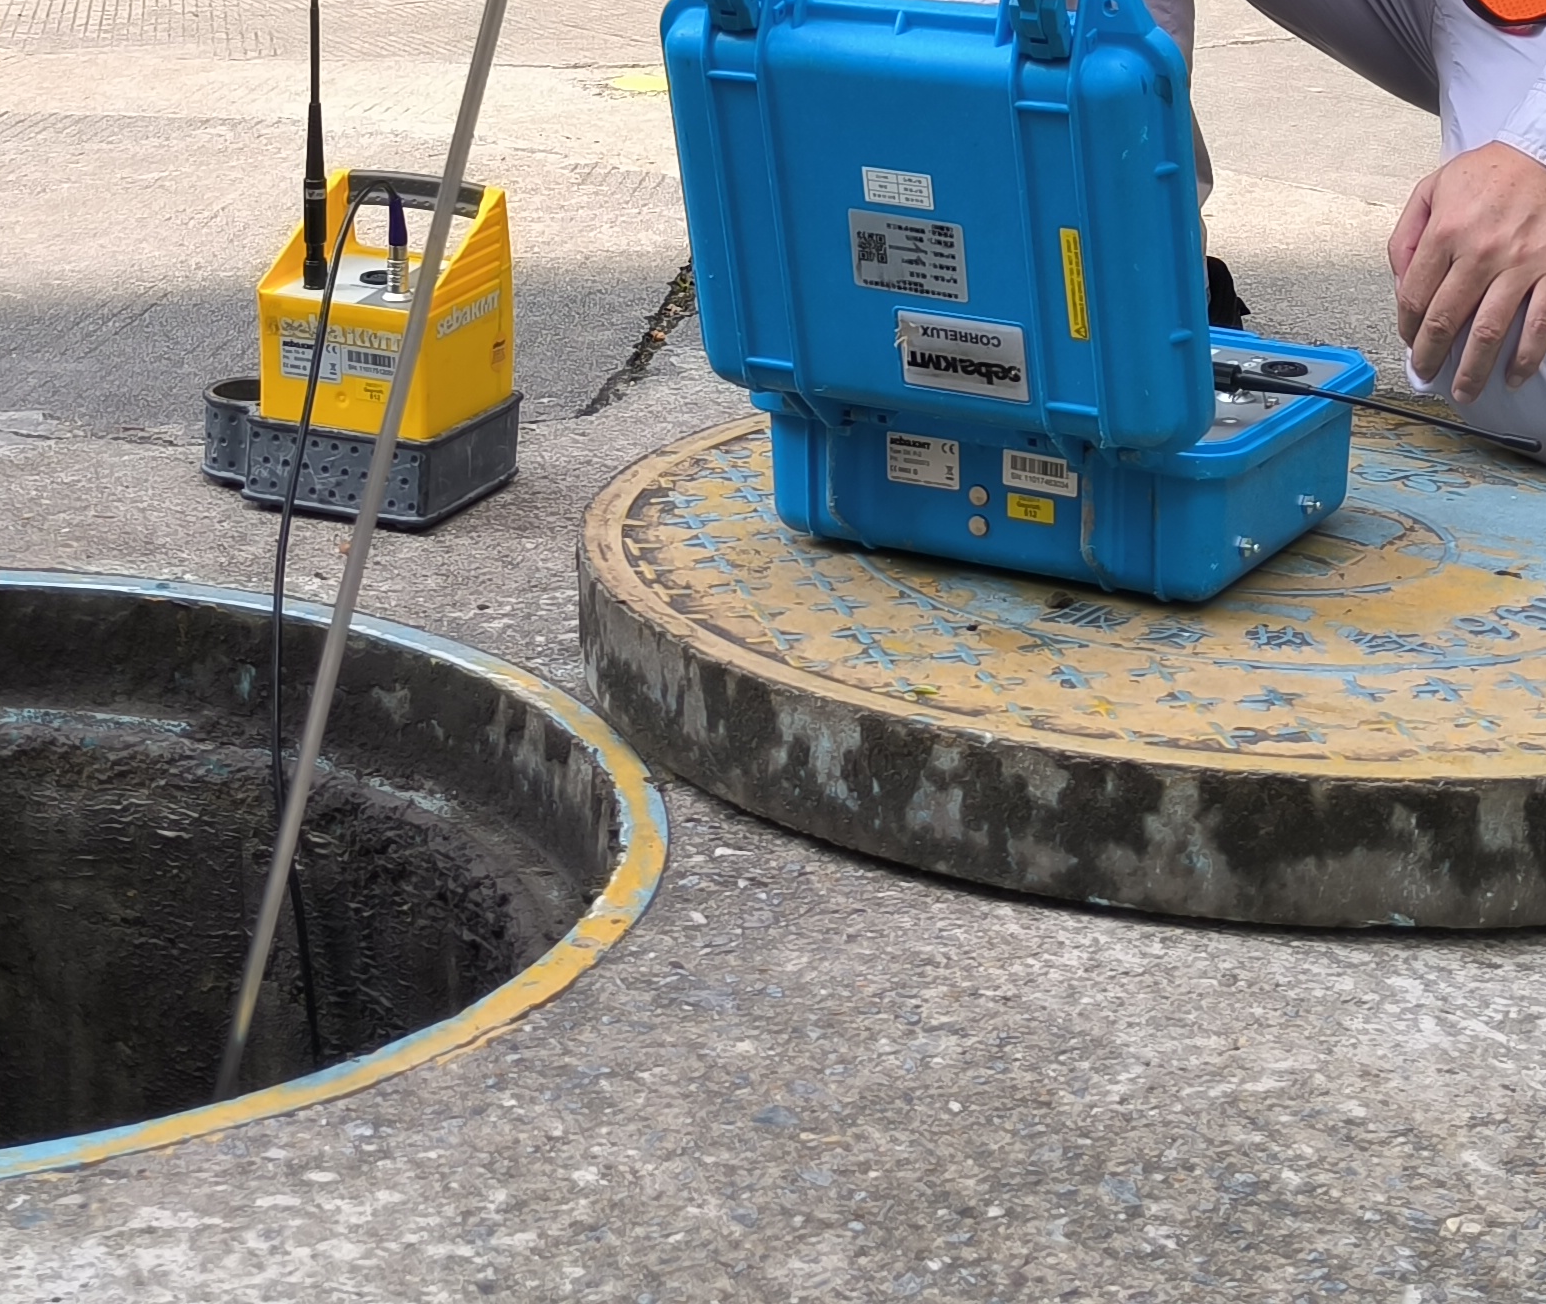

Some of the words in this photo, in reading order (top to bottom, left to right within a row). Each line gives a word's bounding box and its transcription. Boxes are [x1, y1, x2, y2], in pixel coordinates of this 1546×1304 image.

[436, 290, 500, 339] sebaKMT
[920, 324, 1002, 347] CORRELUX
[907, 350, 1022, 385] sebaKMT
